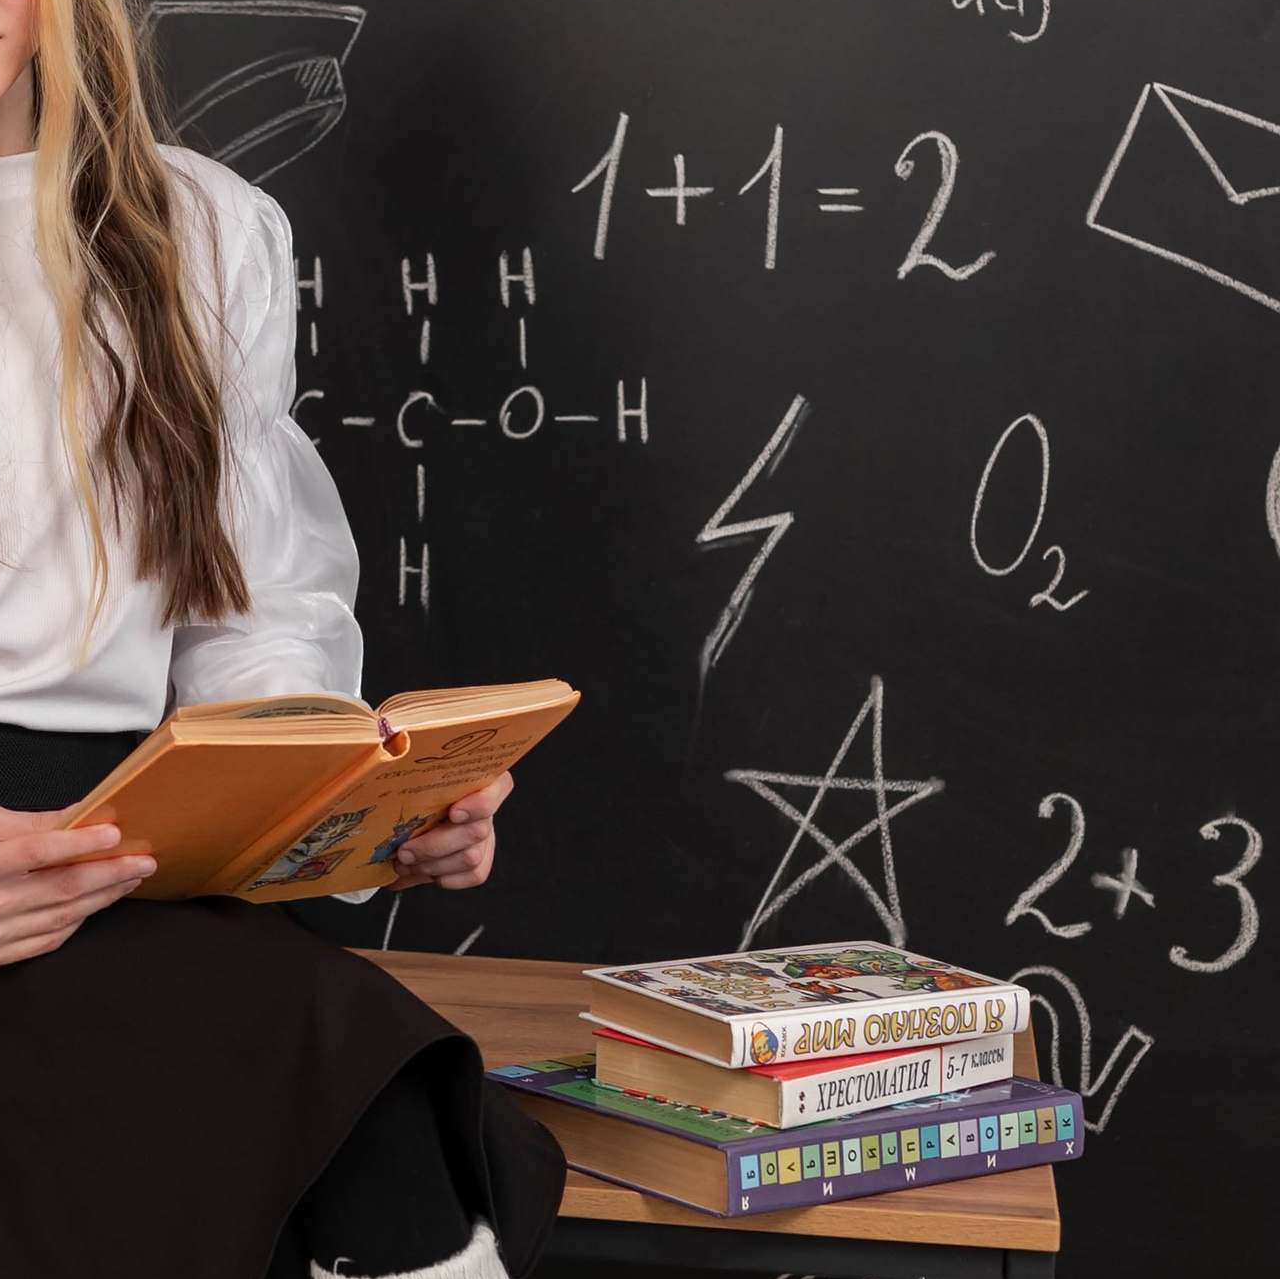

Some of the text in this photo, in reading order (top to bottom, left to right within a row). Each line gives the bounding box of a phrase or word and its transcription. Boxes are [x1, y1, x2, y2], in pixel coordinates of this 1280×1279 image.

[793, 999, 1007, 1057] Я ПОЗНАЮ МИР
[815, 1057, 932, 1114] ХРЕСТОМАТИЯ
[945, 1056, 968, 1082] 5-7
